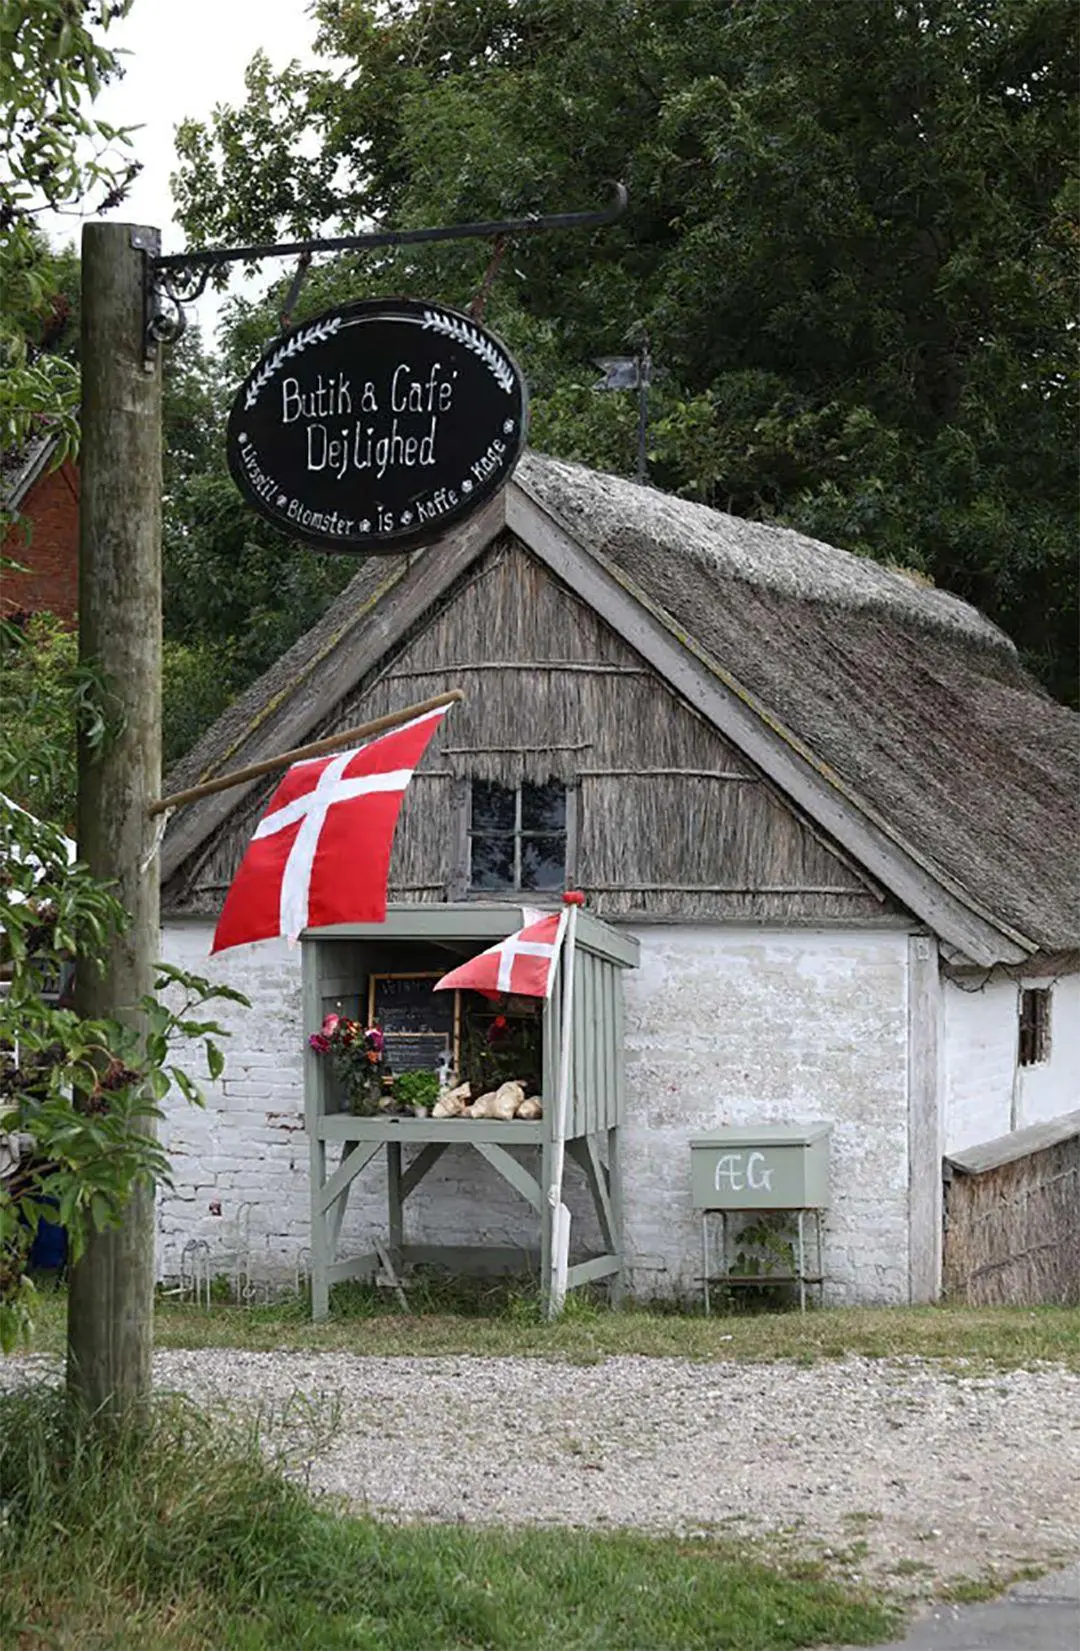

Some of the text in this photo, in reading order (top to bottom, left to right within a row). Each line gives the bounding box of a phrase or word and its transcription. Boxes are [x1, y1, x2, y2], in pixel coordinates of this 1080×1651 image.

[282, 372, 352, 423] Butik
[391, 363, 458, 413] Café
[306, 416, 436, 480] Dejlighed
[240, 443, 280, 502] Livsstil
[286, 498, 354, 535] Blomster
[470, 438, 507, 482] Kage
[714, 1151, 775, 1192] ÆG
